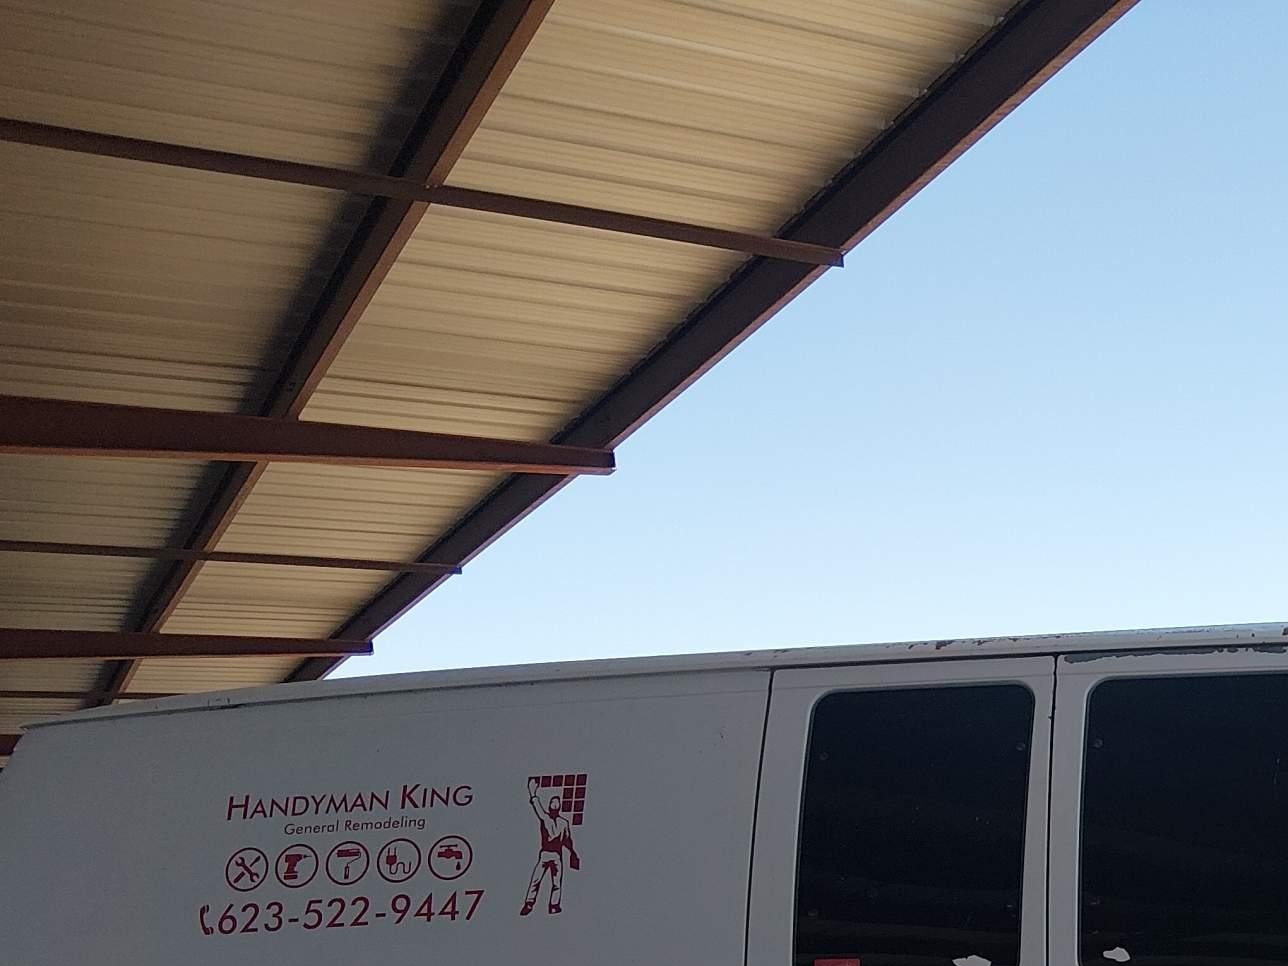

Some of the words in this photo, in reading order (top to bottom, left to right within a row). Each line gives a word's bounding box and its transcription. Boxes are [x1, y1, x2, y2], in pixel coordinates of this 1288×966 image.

[227, 790, 390, 821] HANDYMAN
[400, 784, 474, 809] KING
[284, 820, 340, 836] General
[345, 816, 426, 831] Remodeling
[217, 889, 485, 935] 623-522-9447
